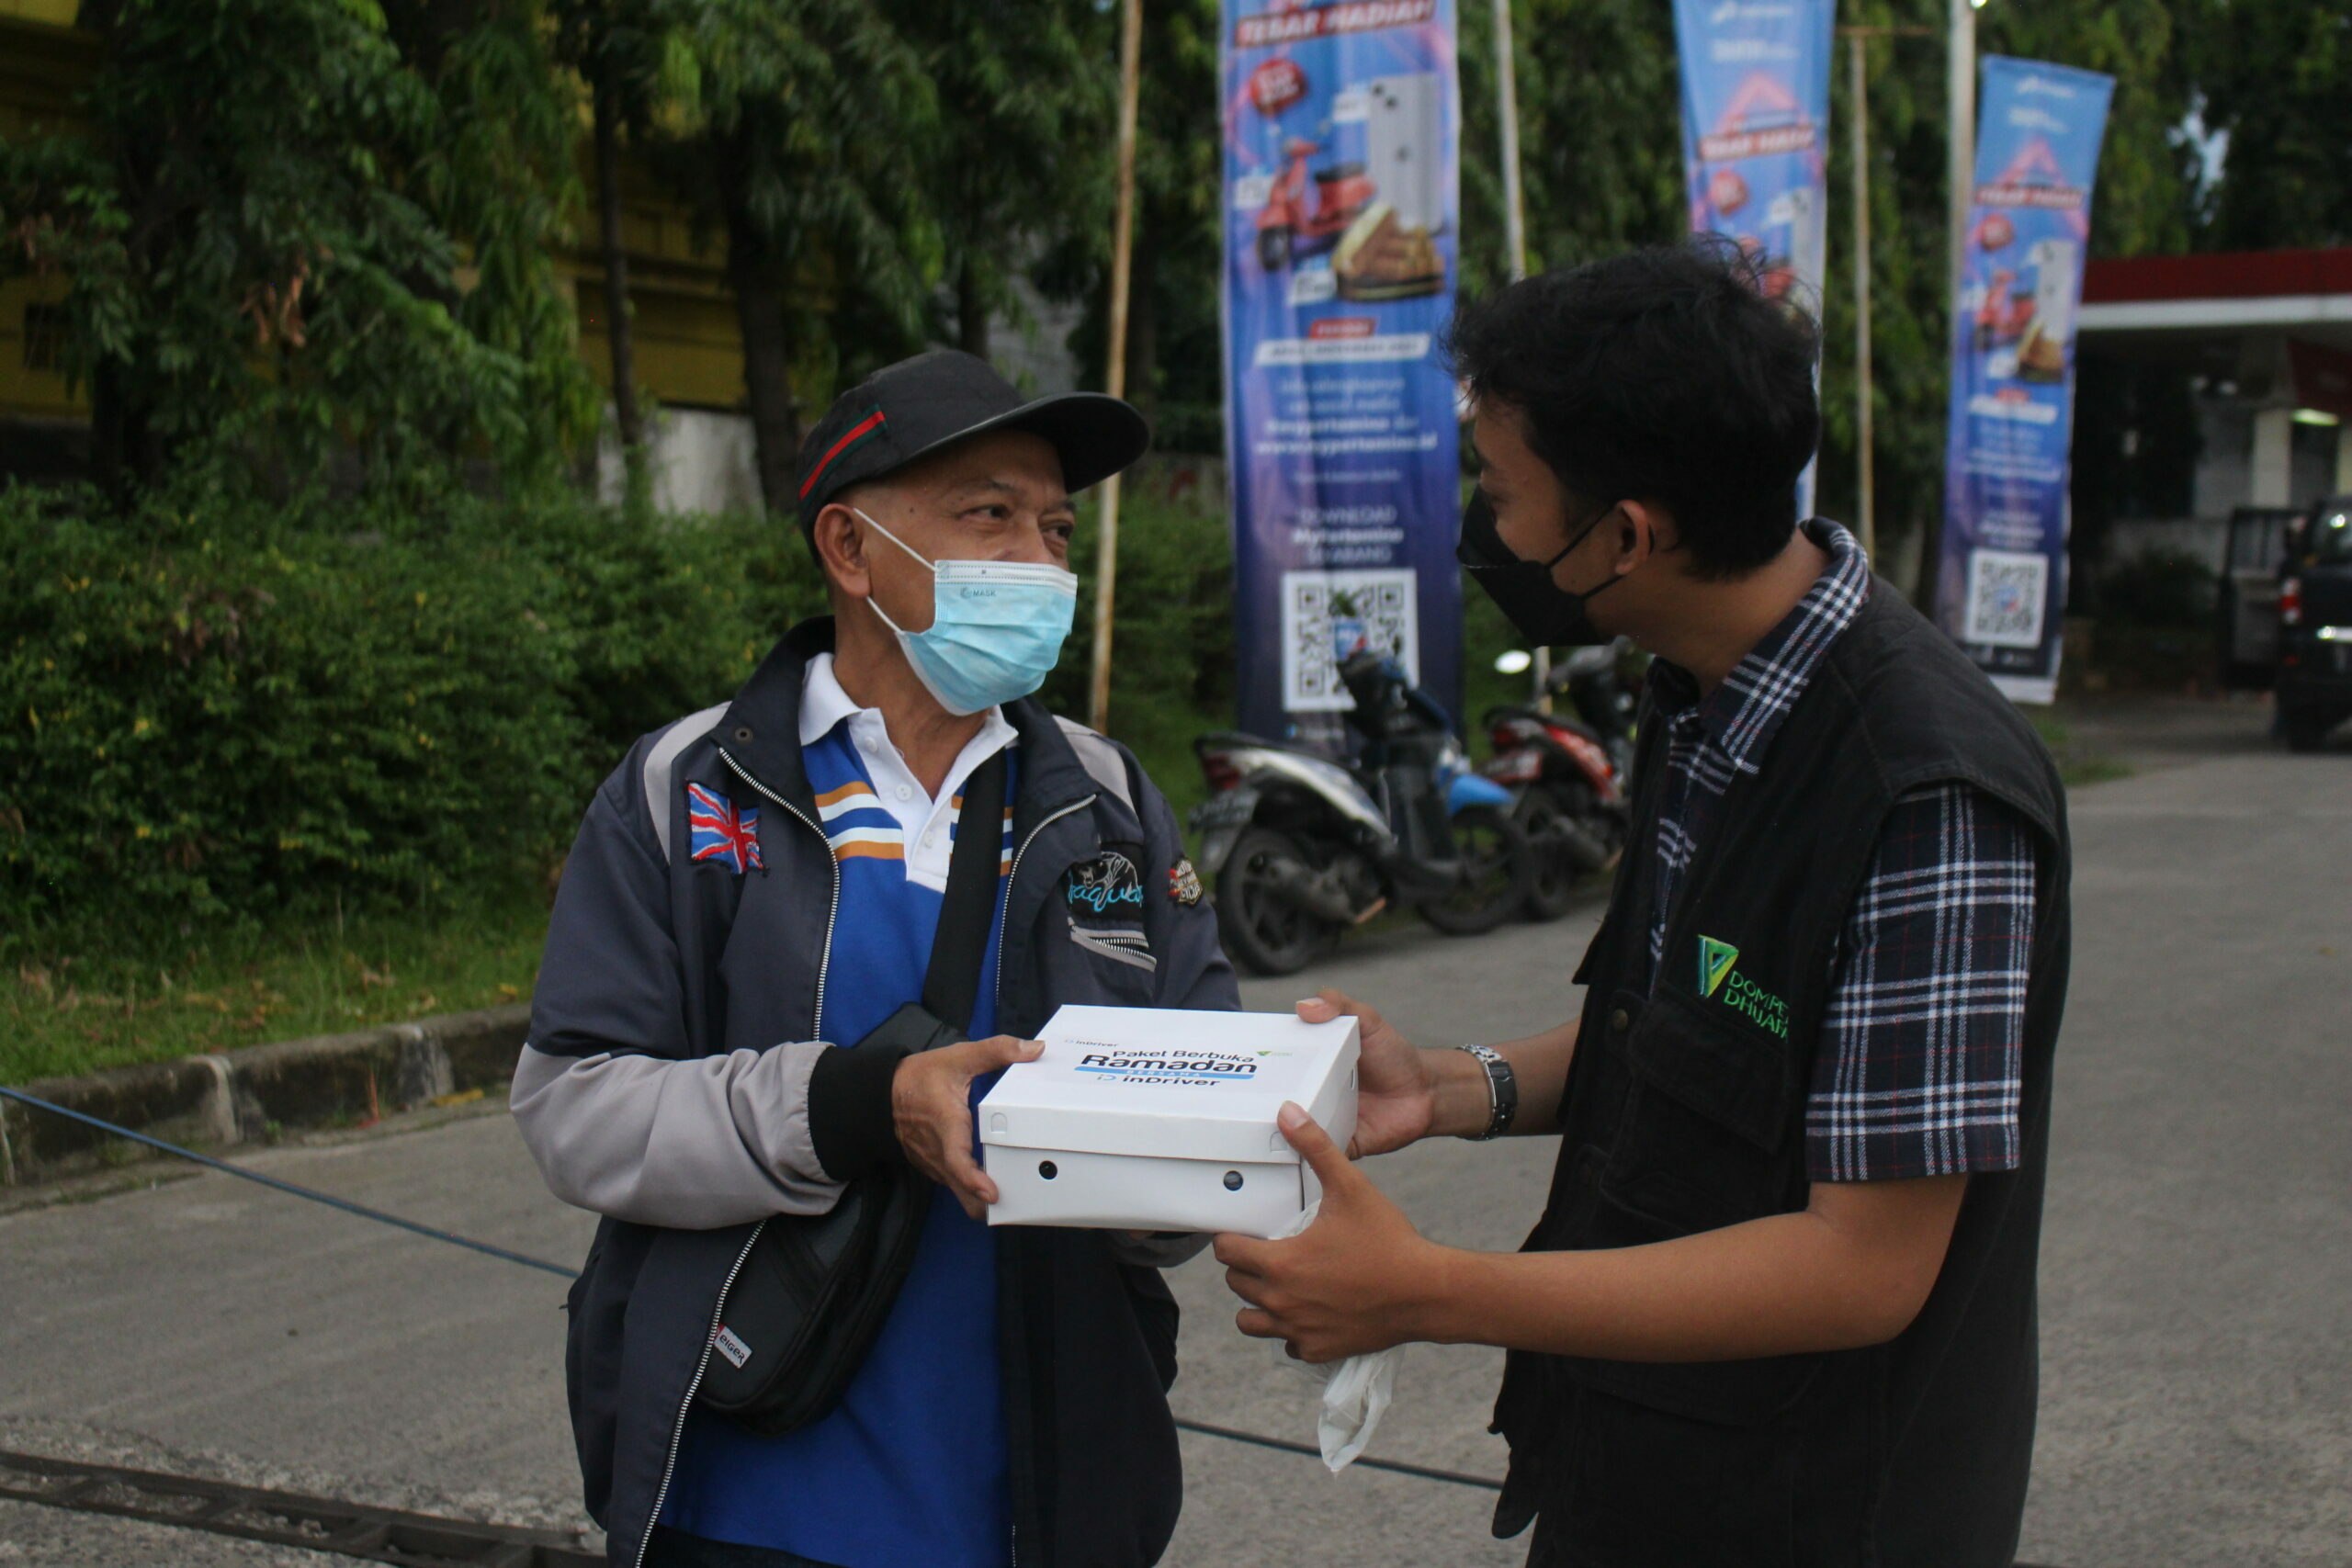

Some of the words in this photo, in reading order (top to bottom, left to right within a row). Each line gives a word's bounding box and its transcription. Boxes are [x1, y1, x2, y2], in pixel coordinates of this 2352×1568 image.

[1113, 1050, 1167, 1058] Paket
[1172, 1050, 1255, 1063] Berbuka
[1080, 1055, 1257, 1073] Ramadan
[1126, 1069, 1201, 1077] BERSAMA
[1123, 1075, 1221, 1086] inDriver
